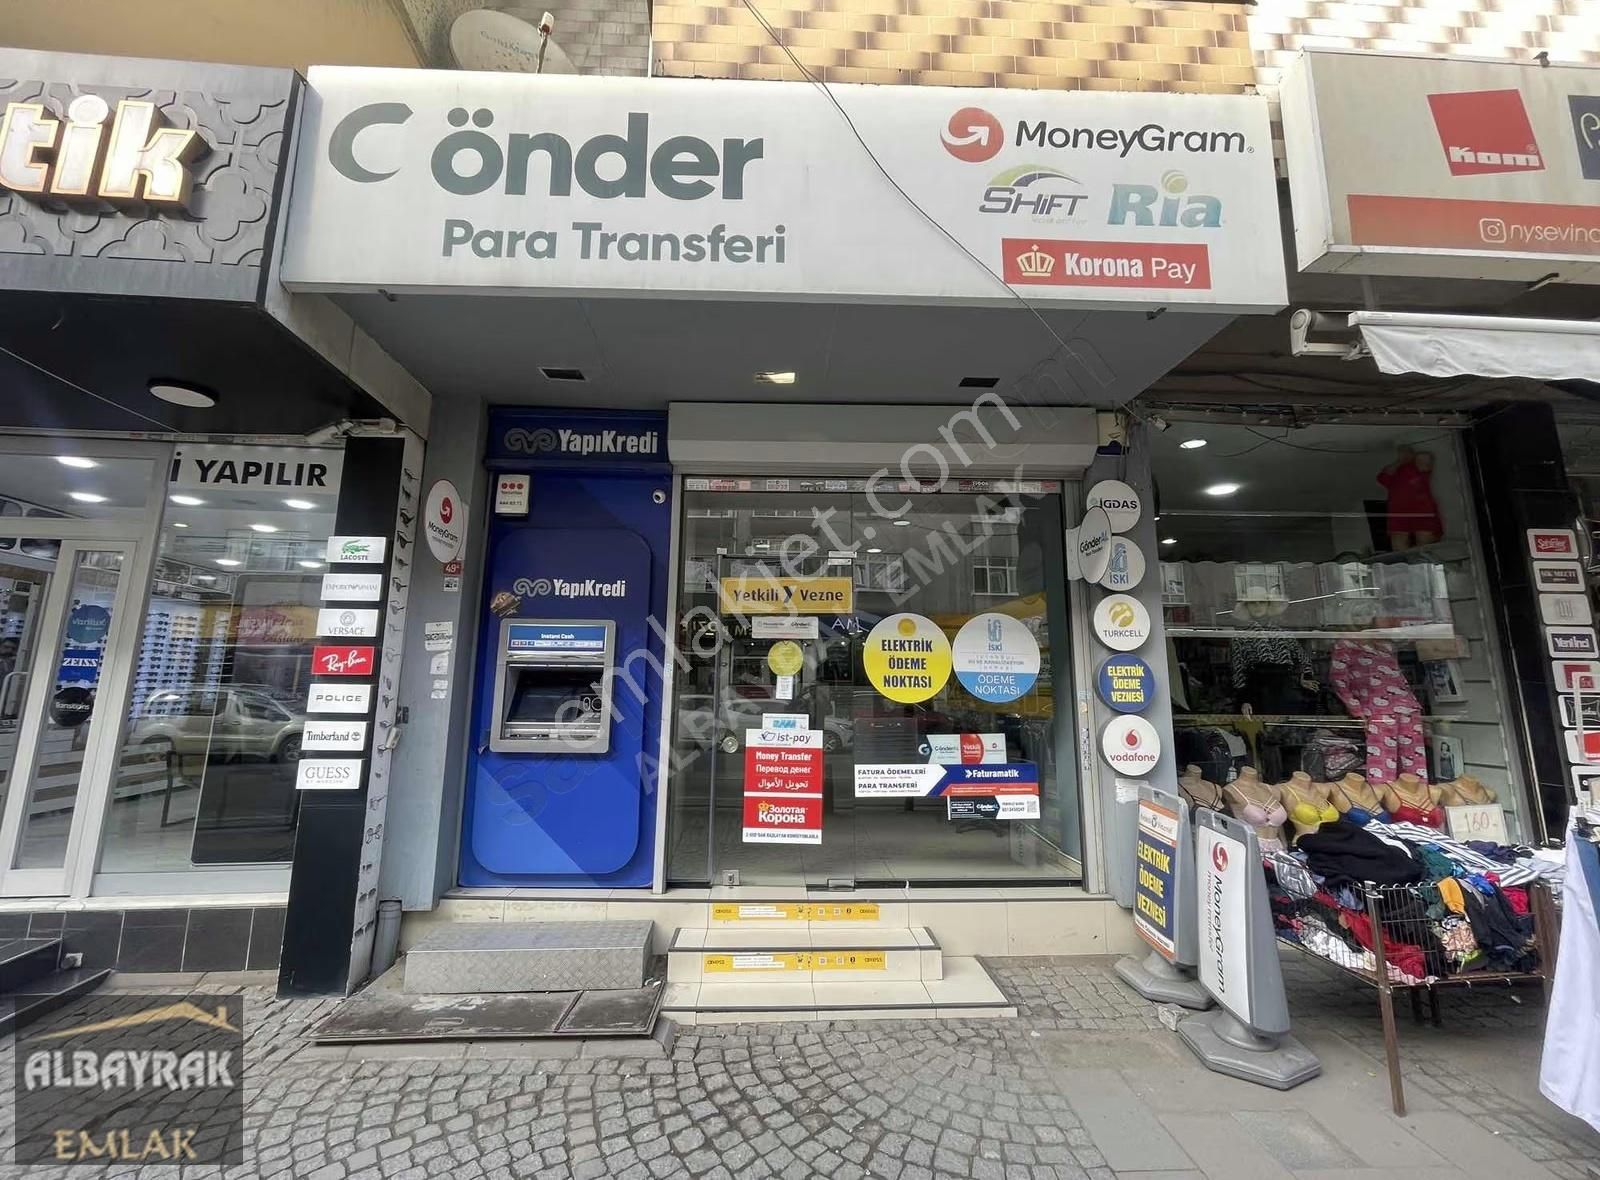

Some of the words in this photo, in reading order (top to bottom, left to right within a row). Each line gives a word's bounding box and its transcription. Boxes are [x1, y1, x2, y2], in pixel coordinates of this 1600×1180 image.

[1015, 120, 1246, 160] MoneyGram
[1106, 171, 1223, 231] Ria
[442, 219, 557, 259] Para
[572, 221, 786, 264] Transferi
[1064, 252, 1145, 279] Korona
[1151, 256, 1197, 285] Pay
[194, 458, 328, 488] YAPILIR
[733, 587, 779, 602] Yetkili
[800, 589, 844, 602] Vezne
[328, 627, 366, 636] VERSACE
[1102, 629, 1144, 638] TURKCELL
[881, 637, 934, 653] ELEKTRİK
[62, 657, 99, 667] ZEISS
[888, 655, 927, 670] ÖDEME
[1107, 664, 1145, 677] ELEKTRİK
[883, 675, 932, 689] NOKTASI
[1112, 677, 1141, 690] ÖDEME
[974, 685, 1020, 697] NOKTASI
[315, 694, 363, 703] POLICE
[306, 730, 350, 742] Timberland
[756, 751, 779, 762] Money
[781, 751, 813, 761] Transfer
[1109, 752, 1156, 763] vodafone
[304, 767, 351, 779] GUESS
[756, 764, 789, 775] Перевод
[790, 766, 812, 775] денег
[886, 767, 926, 776] ÖDEMELERİ
[972, 769, 1020, 779] Faturamatik
[879, 781, 918, 790] TRANSFERİ
[768, 804, 806, 814] Золотая
[758, 811, 806, 826] Корона
[1137, 840, 1171, 875] ELEKTRİK
[1213, 873, 1225, 994] MoneyGram
